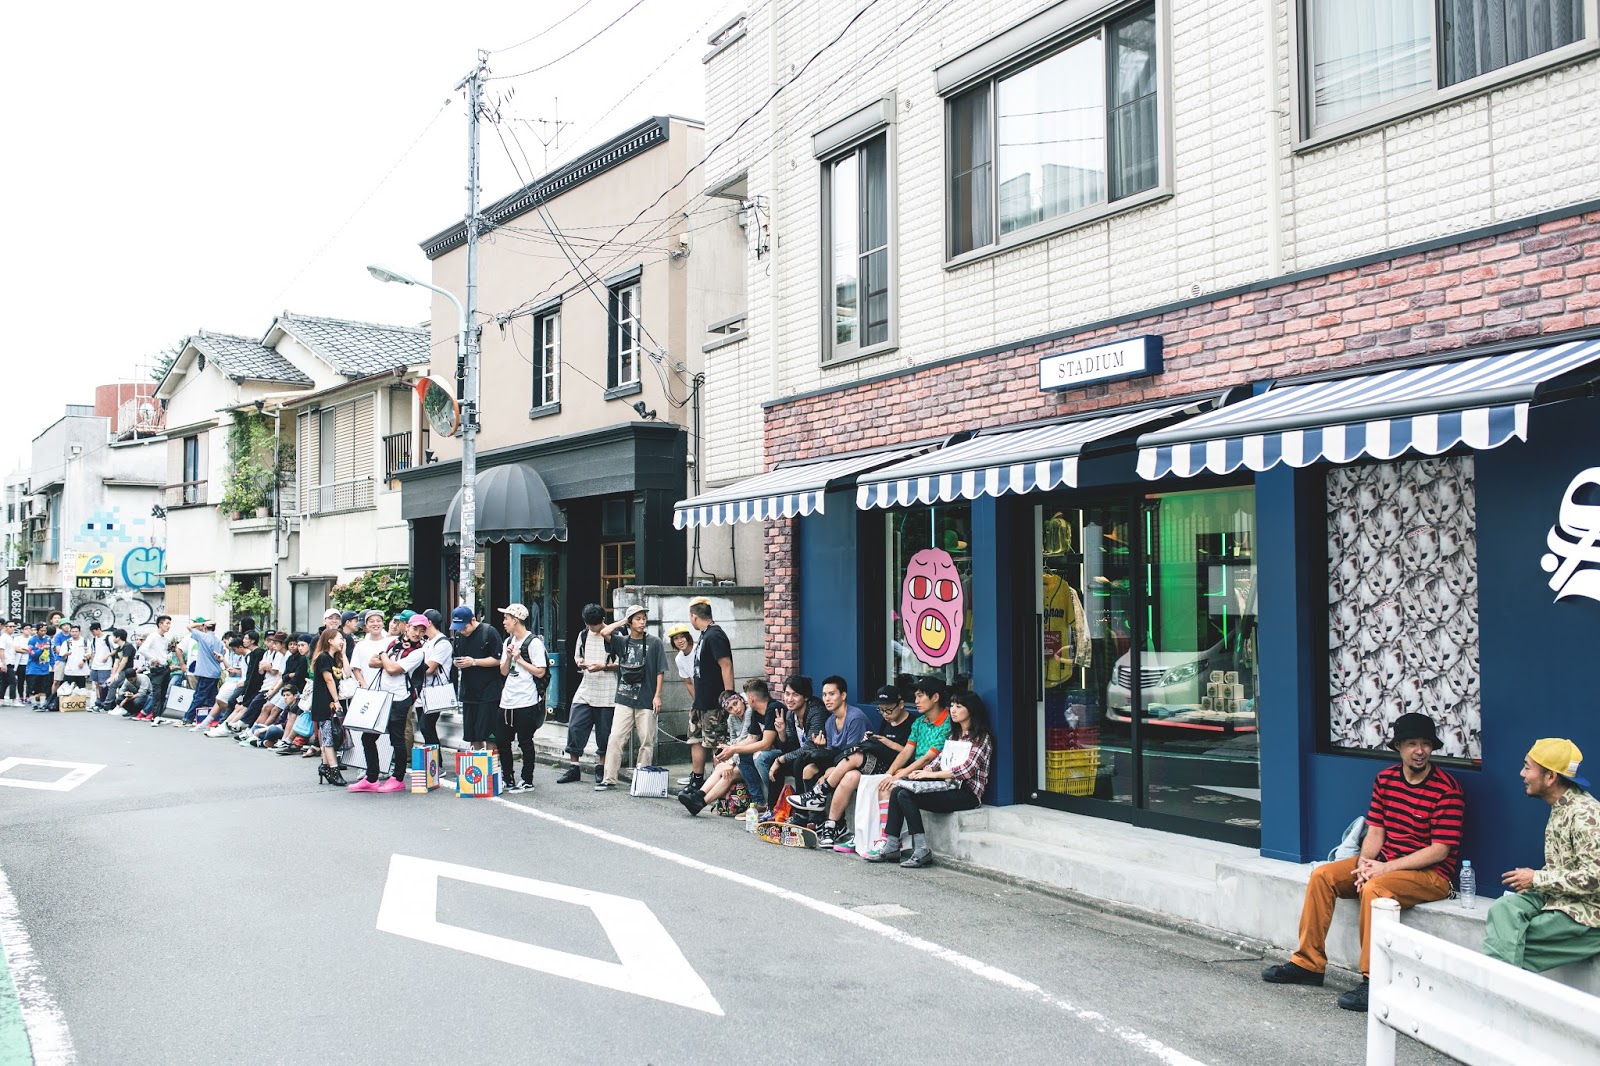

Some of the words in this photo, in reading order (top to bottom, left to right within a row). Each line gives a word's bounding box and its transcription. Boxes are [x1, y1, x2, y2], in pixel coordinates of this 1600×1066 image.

[1058, 351, 1125, 378] STADIUM
[78, 578, 90, 587] IN
[91, 577, 111, 588] 空車
[11, 589, 22, 620] BOSSA
